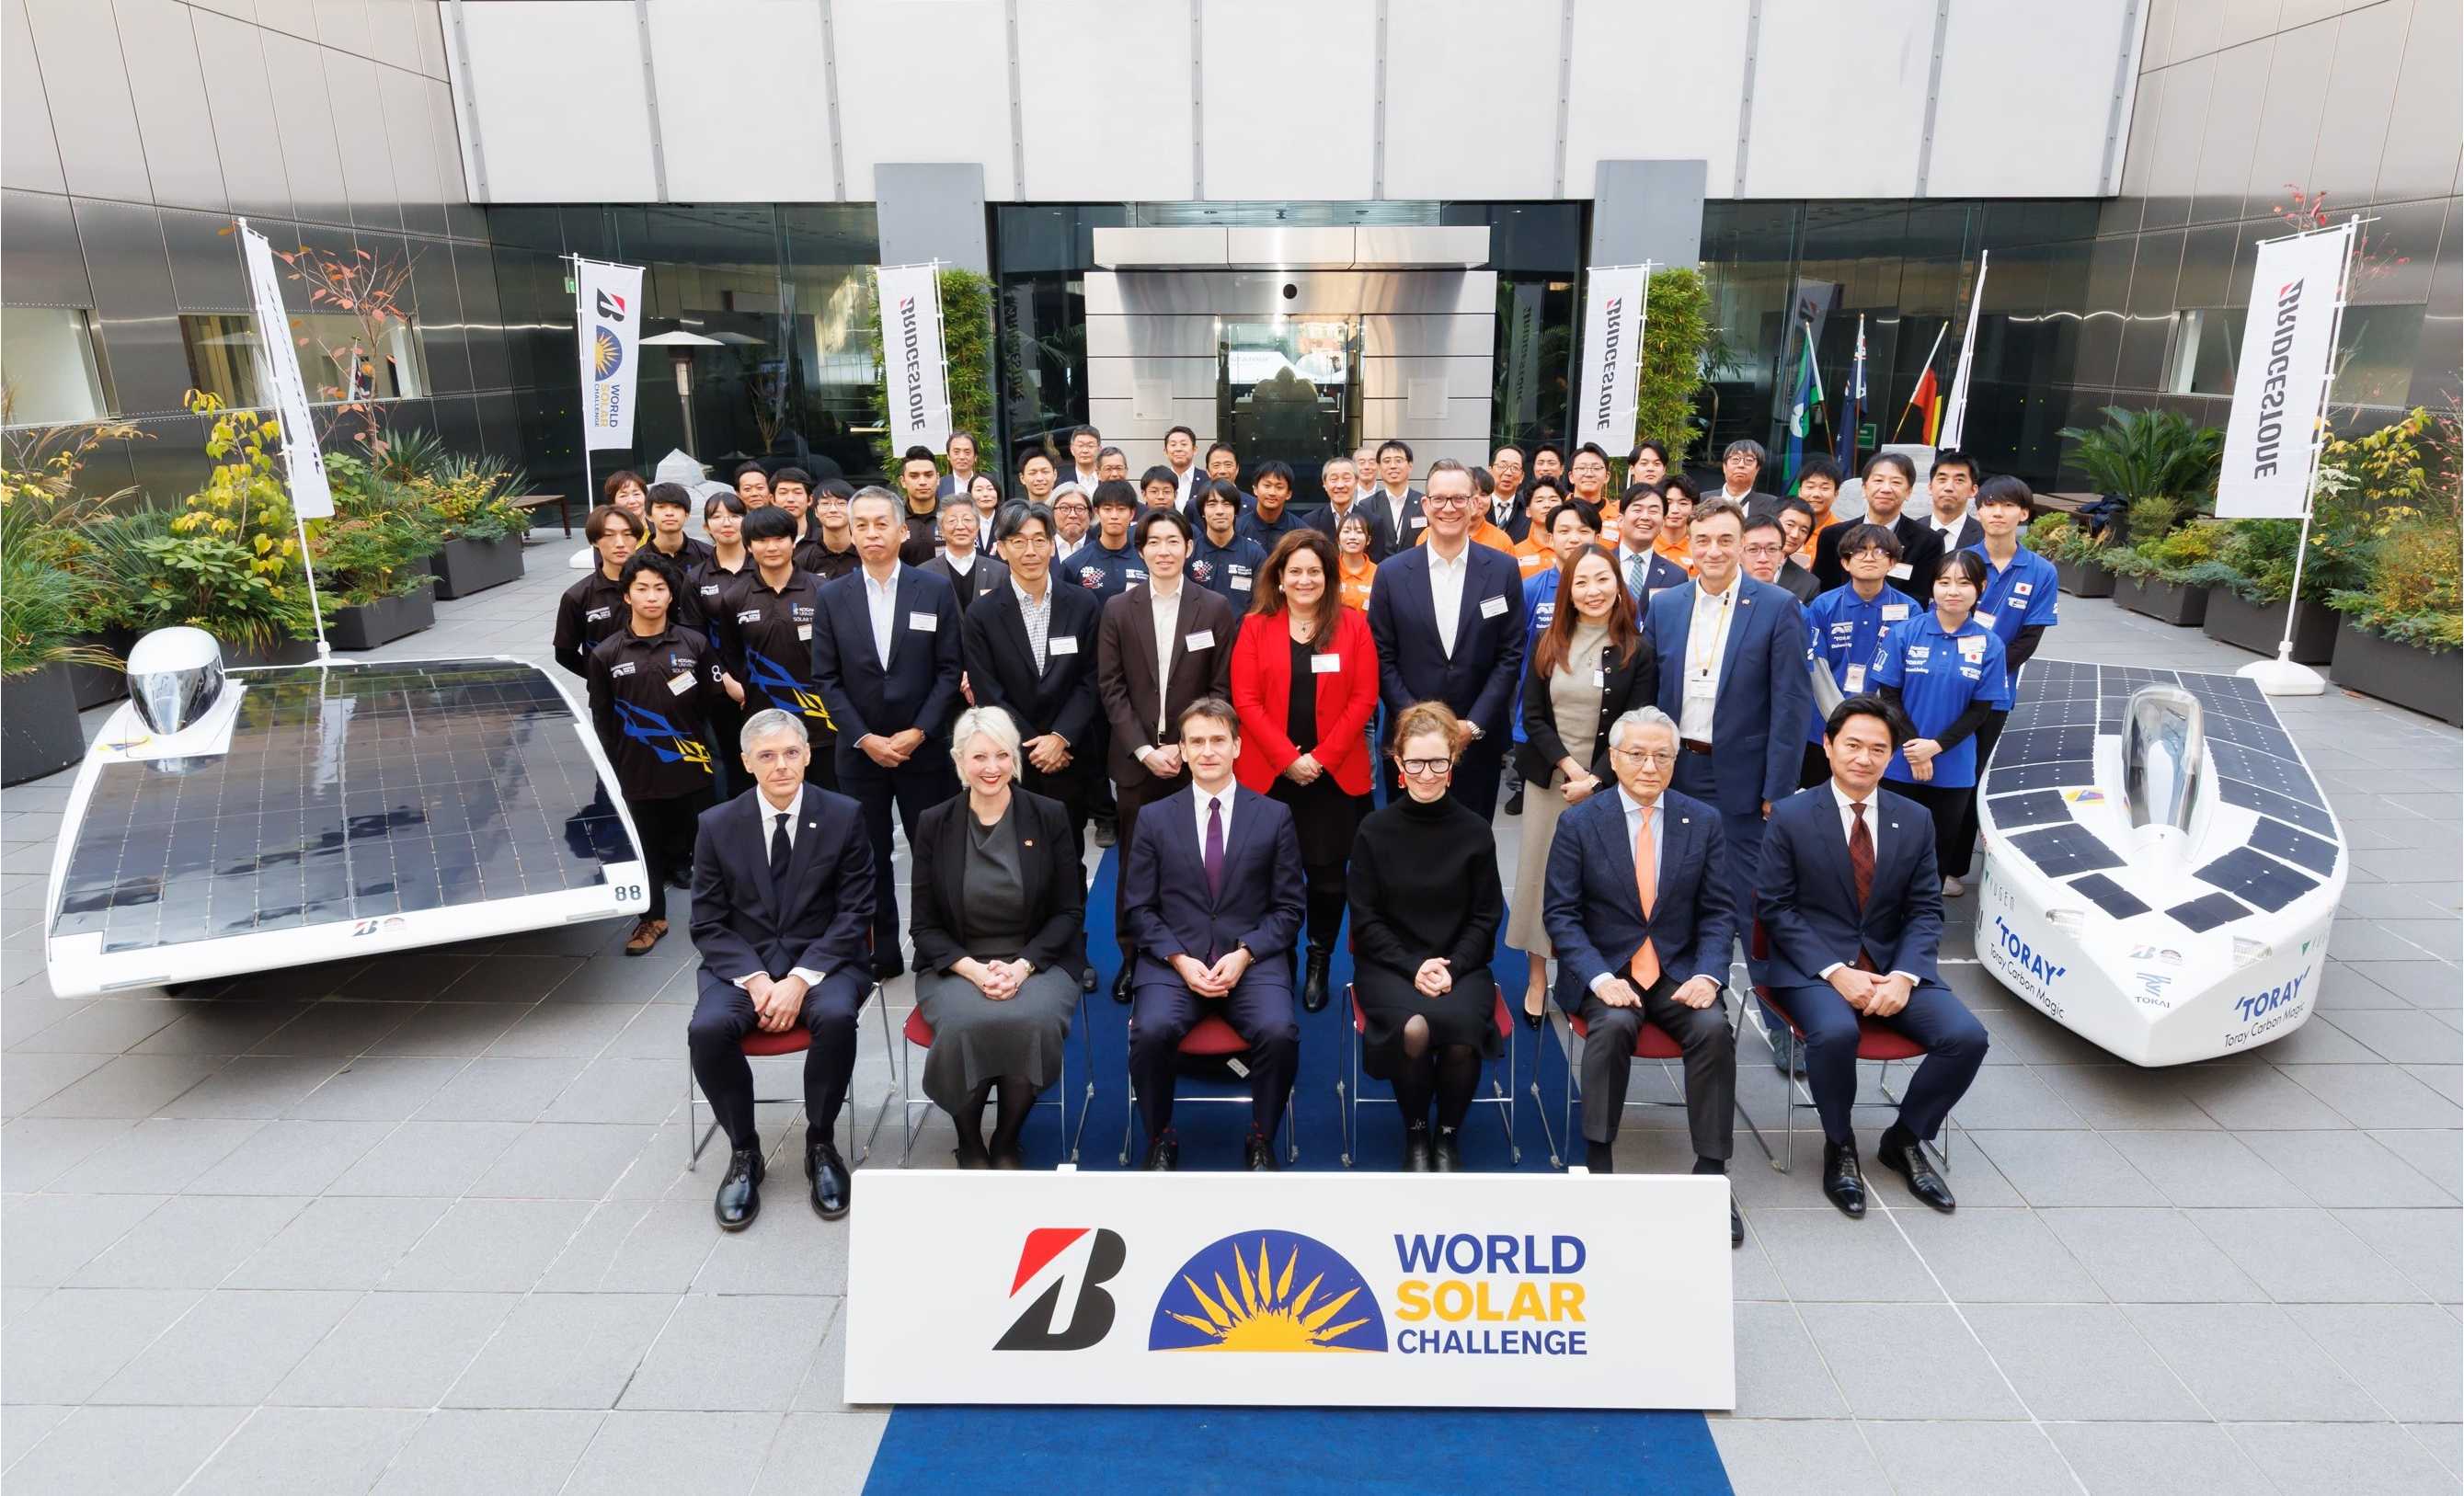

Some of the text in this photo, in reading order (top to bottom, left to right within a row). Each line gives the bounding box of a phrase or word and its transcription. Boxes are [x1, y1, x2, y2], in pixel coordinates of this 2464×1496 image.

[601, 384, 610, 428] SOLAR
[610, 384, 620, 428] WORLD
[615, 885, 641, 901] 88
[1989, 942, 2065, 1019] Toray Carbon Magic
[2225, 1031, 2250, 1047] Toray
[2251, 1015, 2281, 1036] Carbon
[1394, 1234, 1587, 1273] WORLD
[1395, 1281, 1587, 1321] SOLAR
[1396, 1330, 1587, 1355] CHALLENGE
